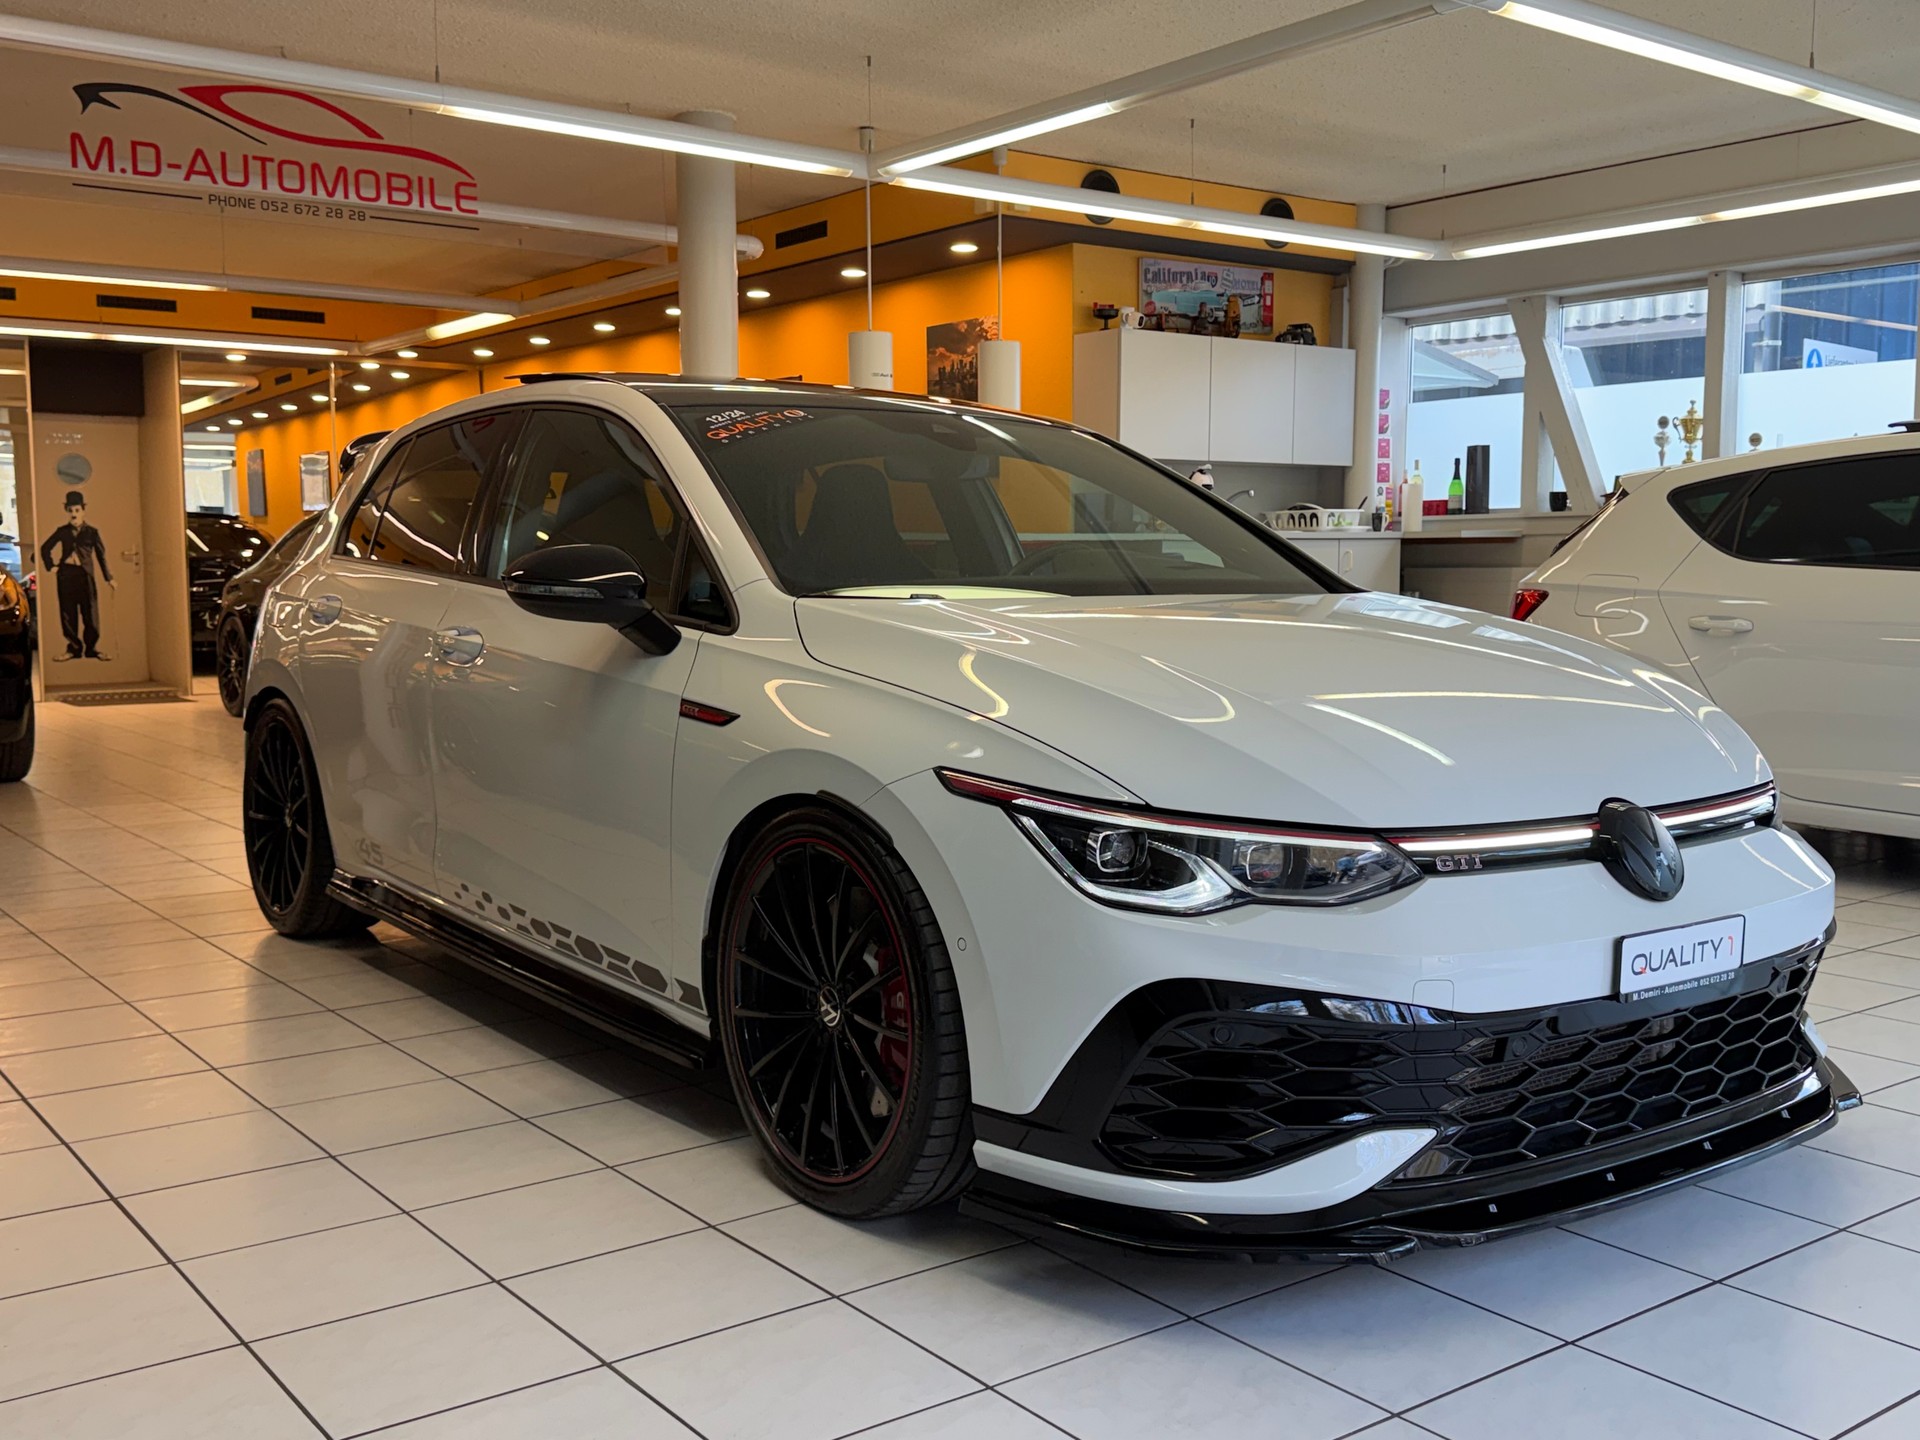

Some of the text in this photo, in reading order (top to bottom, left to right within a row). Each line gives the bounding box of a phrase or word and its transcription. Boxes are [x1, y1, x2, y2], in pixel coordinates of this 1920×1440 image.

[70, 132, 479, 215] M.D-AUTOMOBILE
[208, 193, 366, 222] PHONE 052 672 28 28
[1143, 266, 1207, 284] California
[706, 410, 746, 424] 12/24
[706, 412, 786, 440] QUALITY
[1435, 853, 1483, 872] GTI
[1631, 937, 1724, 976] QUALITY
[1632, 993, 1640, 1001] M.
[1640, 989, 1661, 1000] Demiri
[1664, 980, 1699, 994] Automobile
[1699, 977, 1710, 987] 052
[1728, 971, 1735, 980] 28
